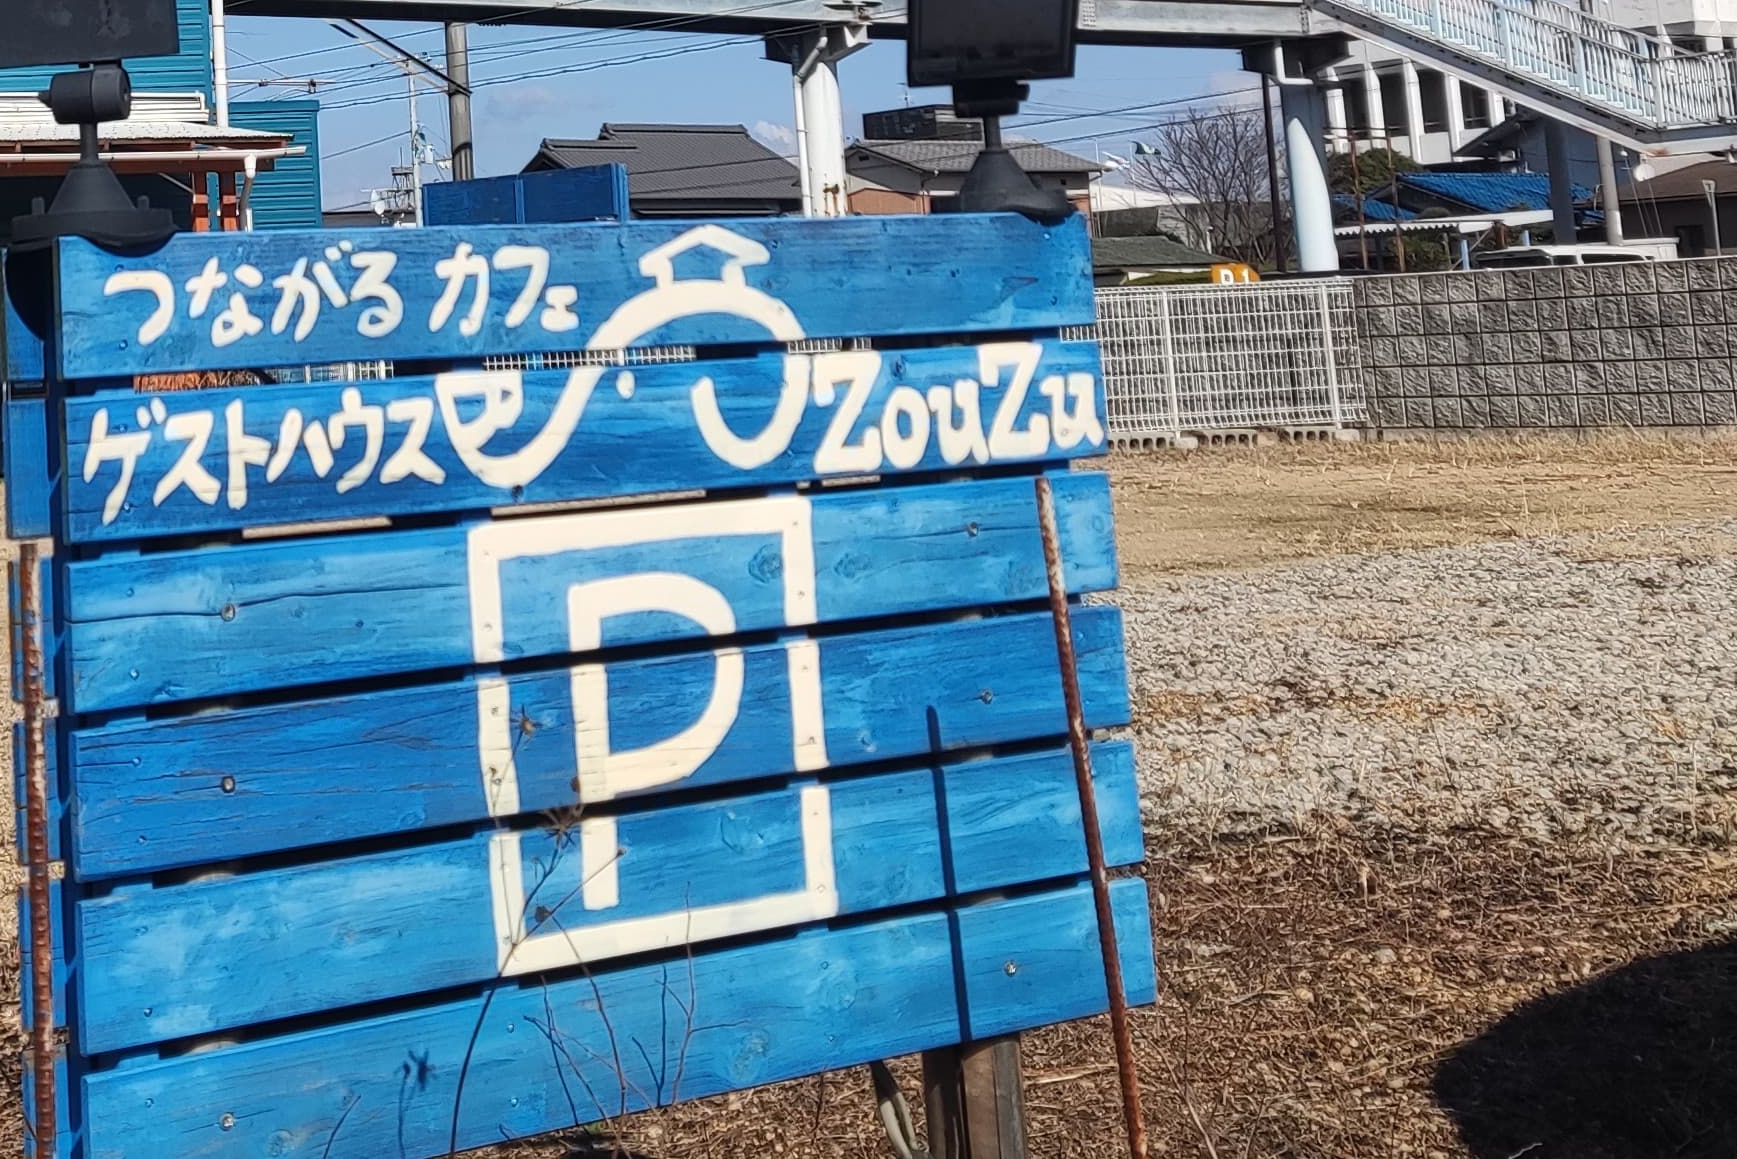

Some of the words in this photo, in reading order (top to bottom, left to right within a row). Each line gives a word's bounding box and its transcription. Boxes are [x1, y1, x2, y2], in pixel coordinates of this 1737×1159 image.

[103, 240, 404, 348] つながる
[428, 241, 580, 337] カフェ
[82, 386, 448, 526] ゲストハウス
[811, 342, 1104, 475] ZouZu
[567, 572, 745, 910] P
